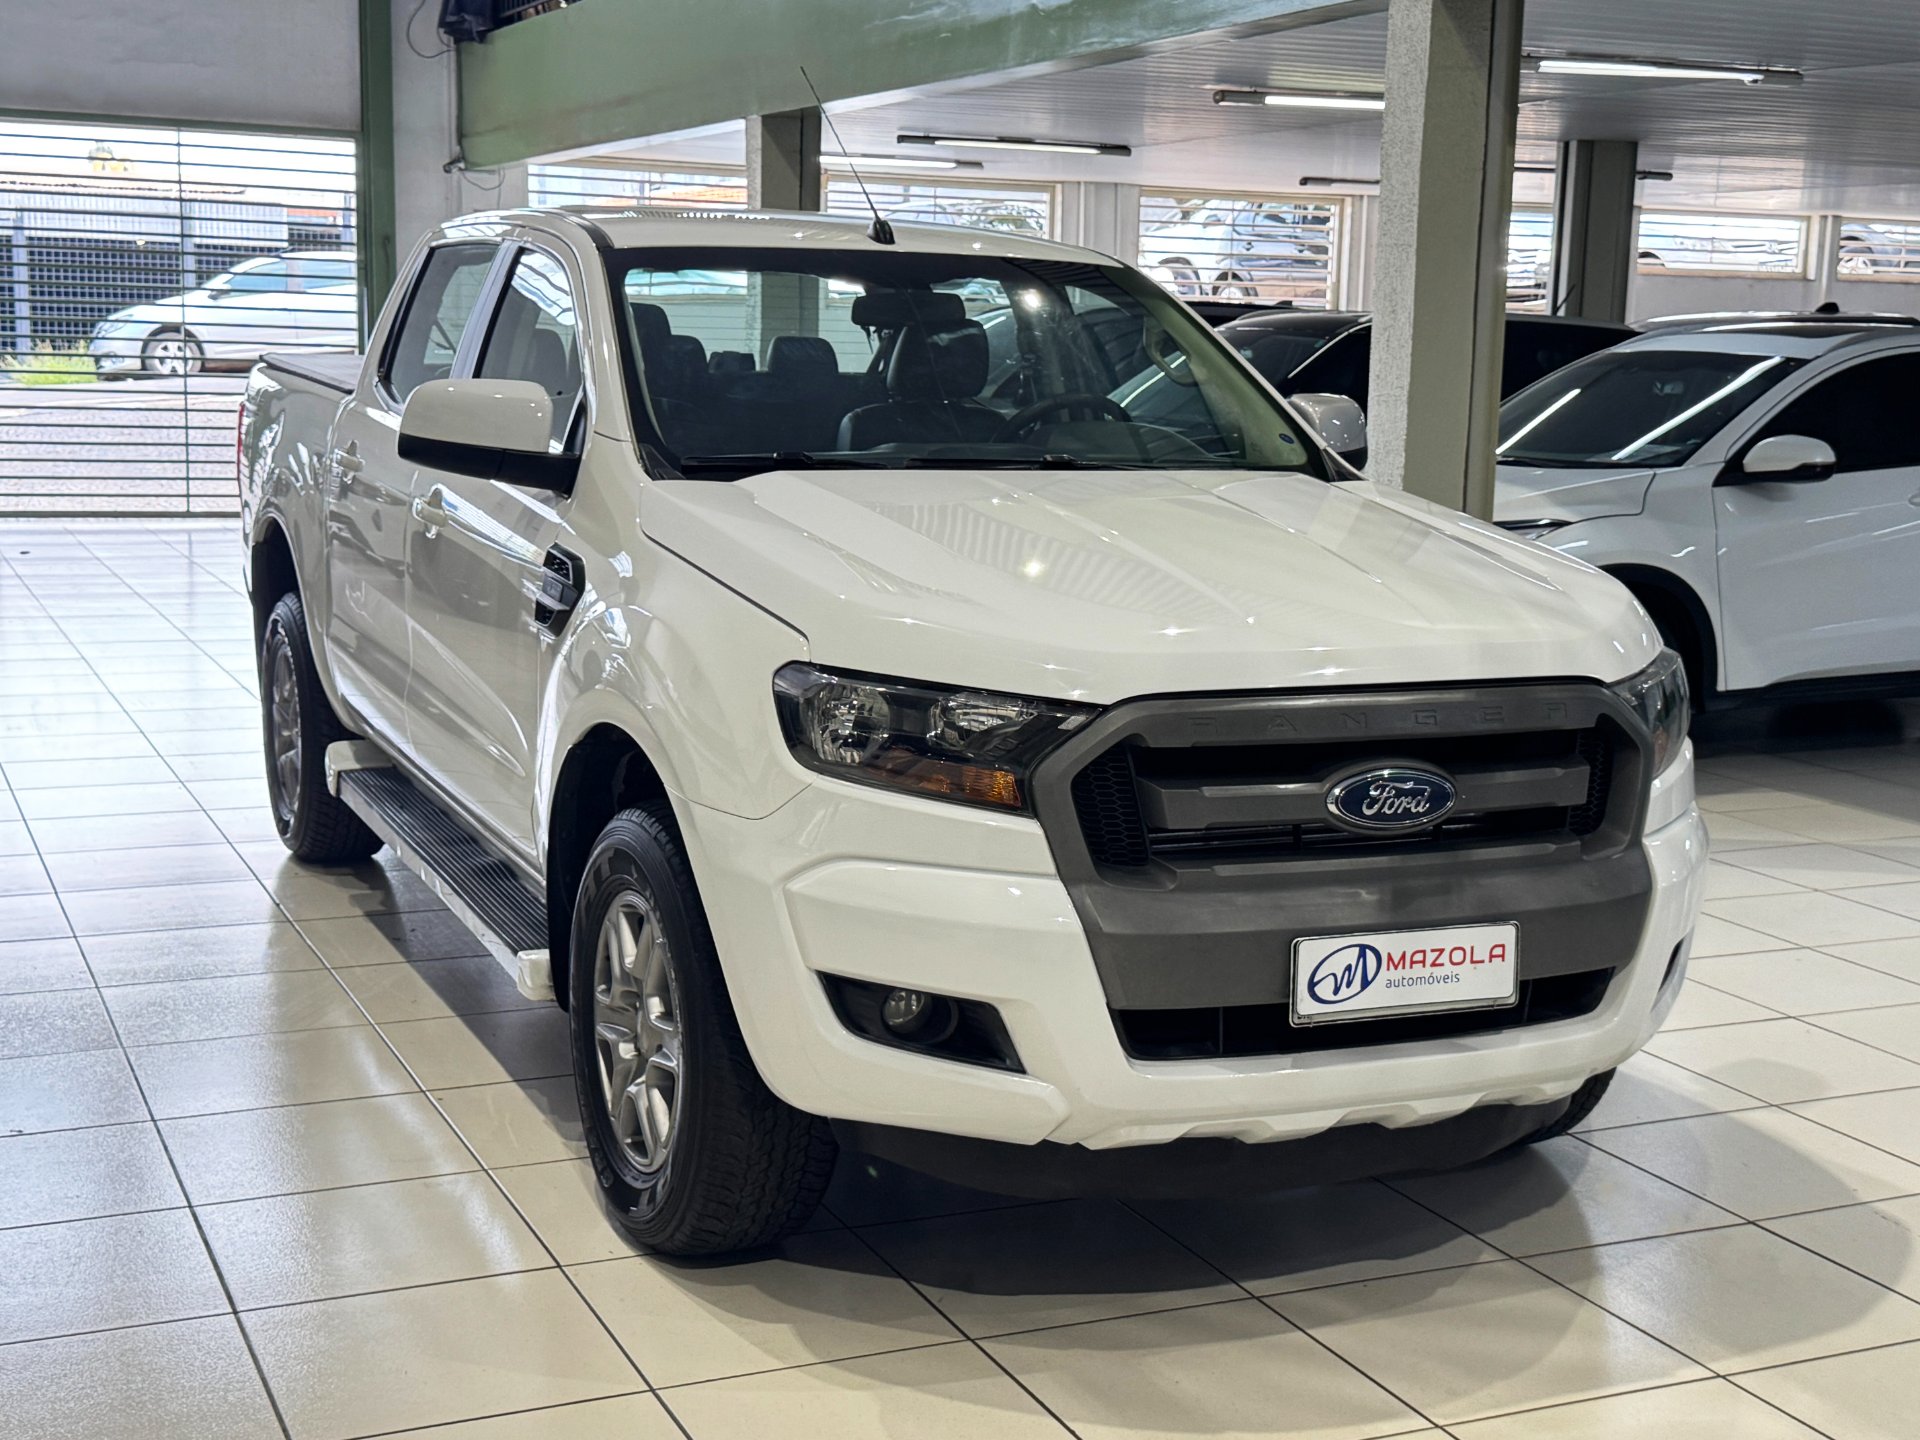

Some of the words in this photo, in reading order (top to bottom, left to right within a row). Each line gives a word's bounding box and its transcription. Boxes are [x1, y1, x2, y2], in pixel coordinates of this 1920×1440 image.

[1187, 702, 1568, 734] RANGER
[1361, 780, 1432, 816] Ford
[1385, 943, 1507, 972] MAZOLA
[1385, 971, 1461, 989] automóveis
